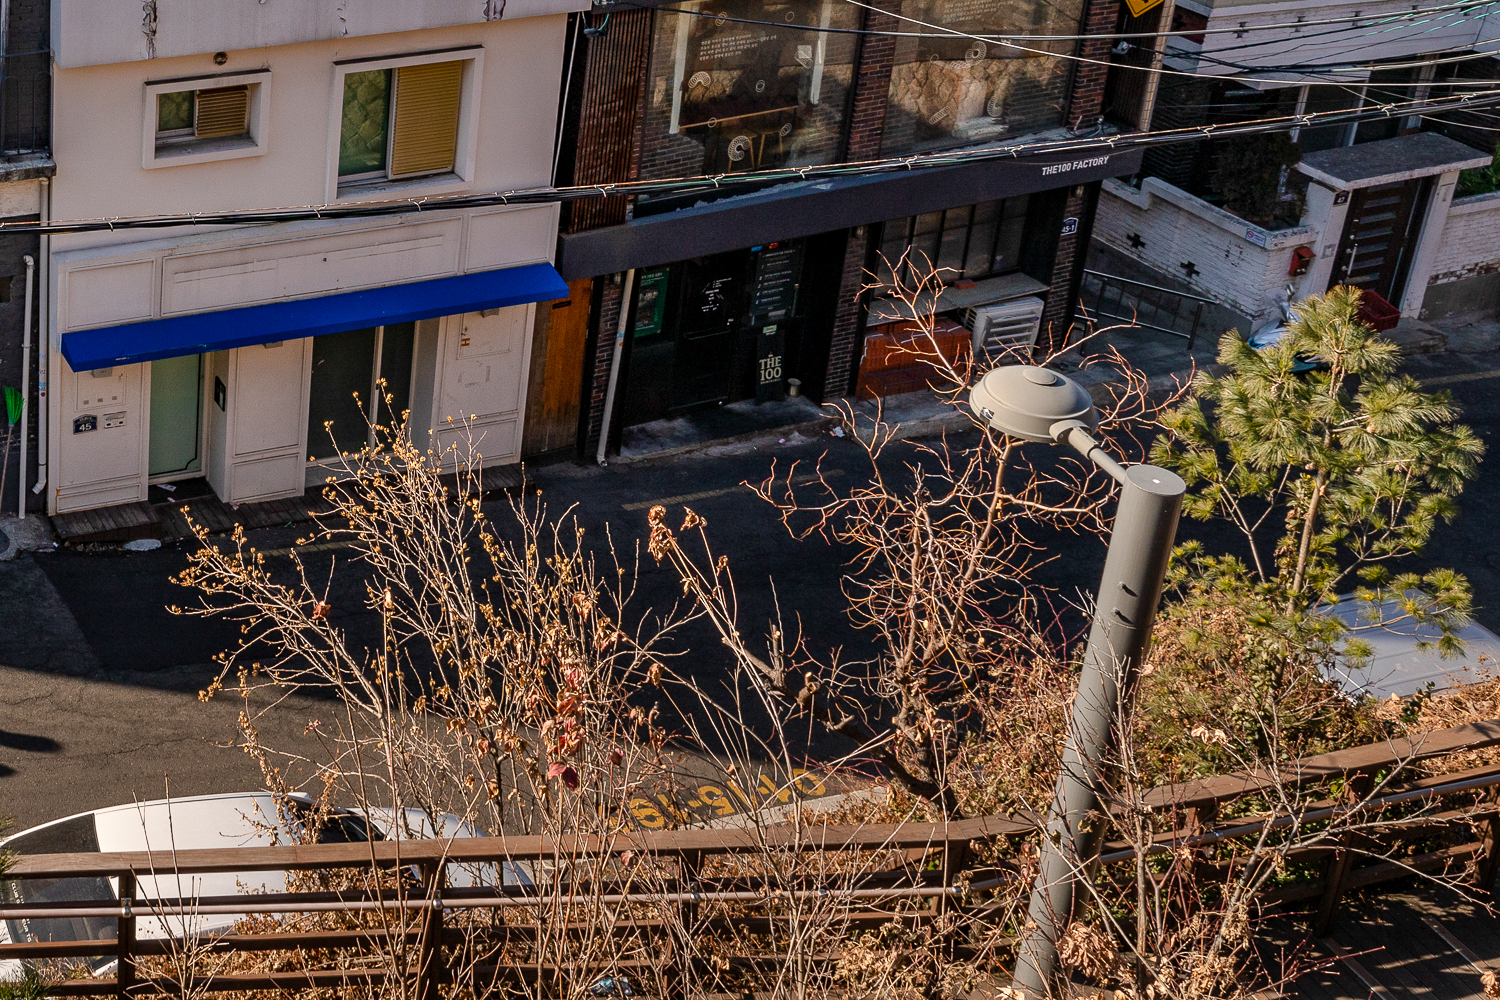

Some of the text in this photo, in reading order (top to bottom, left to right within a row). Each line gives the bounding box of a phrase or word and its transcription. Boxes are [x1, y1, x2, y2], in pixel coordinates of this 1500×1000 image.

[1072, 156, 1110, 170] FACTORY
[759, 355, 782, 370] THE
[760, 367, 782, 381] 100
[79, 422, 92, 431] 45
